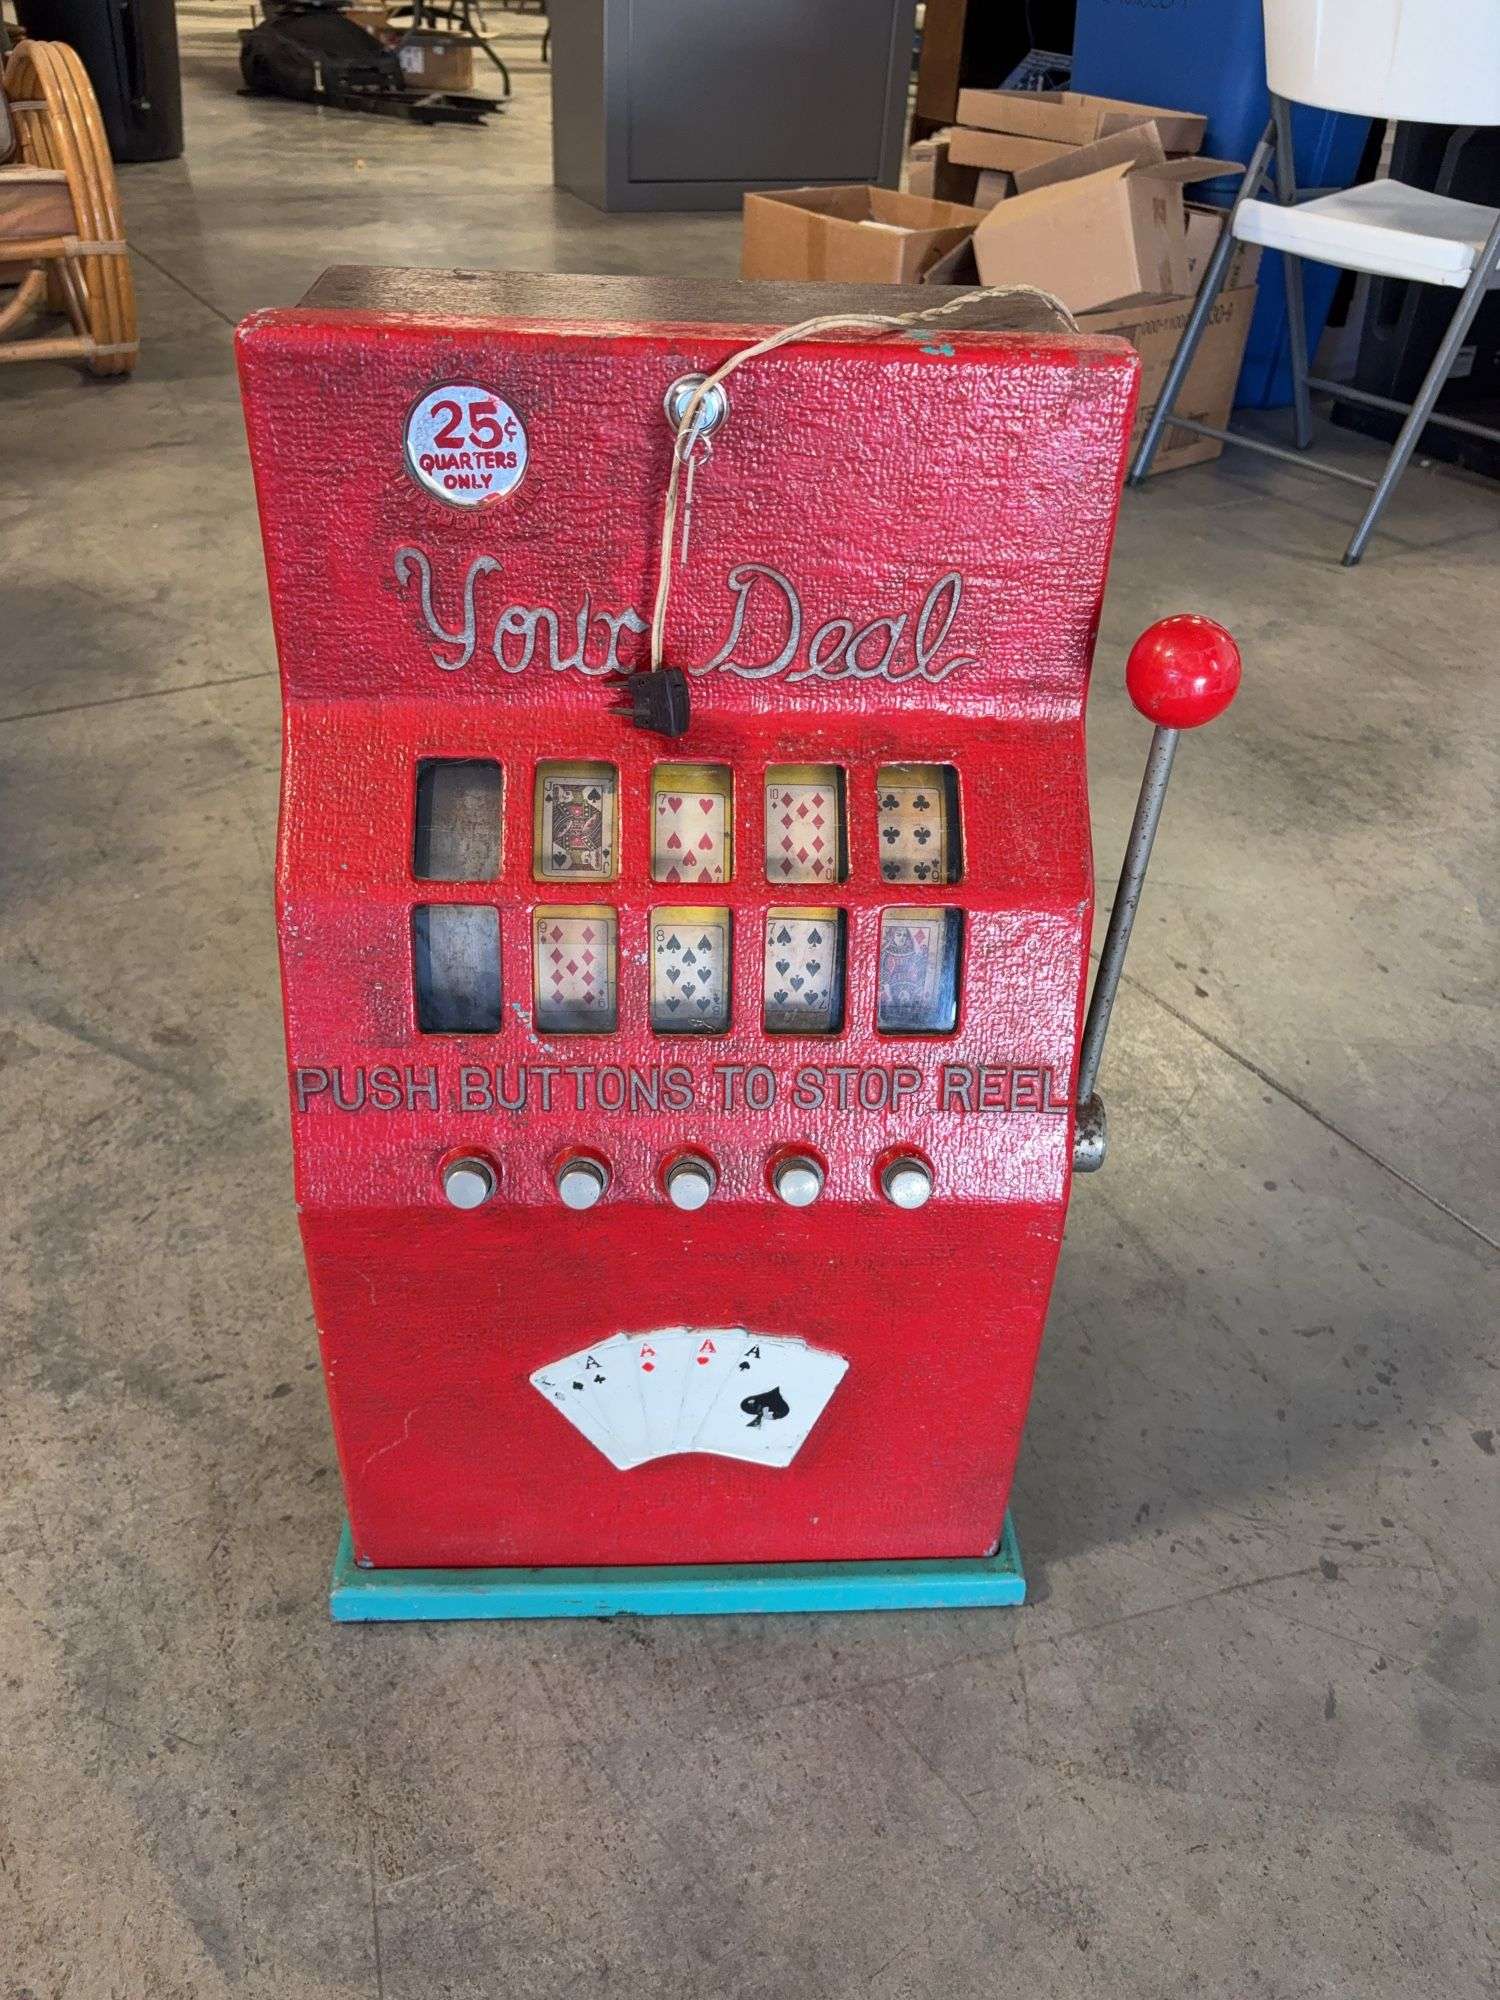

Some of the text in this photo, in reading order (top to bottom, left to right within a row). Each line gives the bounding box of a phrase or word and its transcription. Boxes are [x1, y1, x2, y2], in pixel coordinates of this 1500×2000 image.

[431, 400, 517, 449] 25¢
[419, 451, 517, 475] QUARTERS
[444, 474, 493, 489] ONLY
[394, 546, 977, 683] Your Deal
[545, 781, 553, 791] J
[658, 793, 666, 804] 7
[769, 788, 779, 800] 10
[539, 920, 548, 933] 9
[768, 922, 777, 935] 7
[656, 929, 665, 942] 8
[296, 1065, 1068, 1115] PUSH BUTTONS TO STOP REEL
[640, 1344, 656, 1358] A
[700, 1338, 717, 1354] A
[745, 1344, 761, 1359] A
[585, 1356, 602, 1370] A
